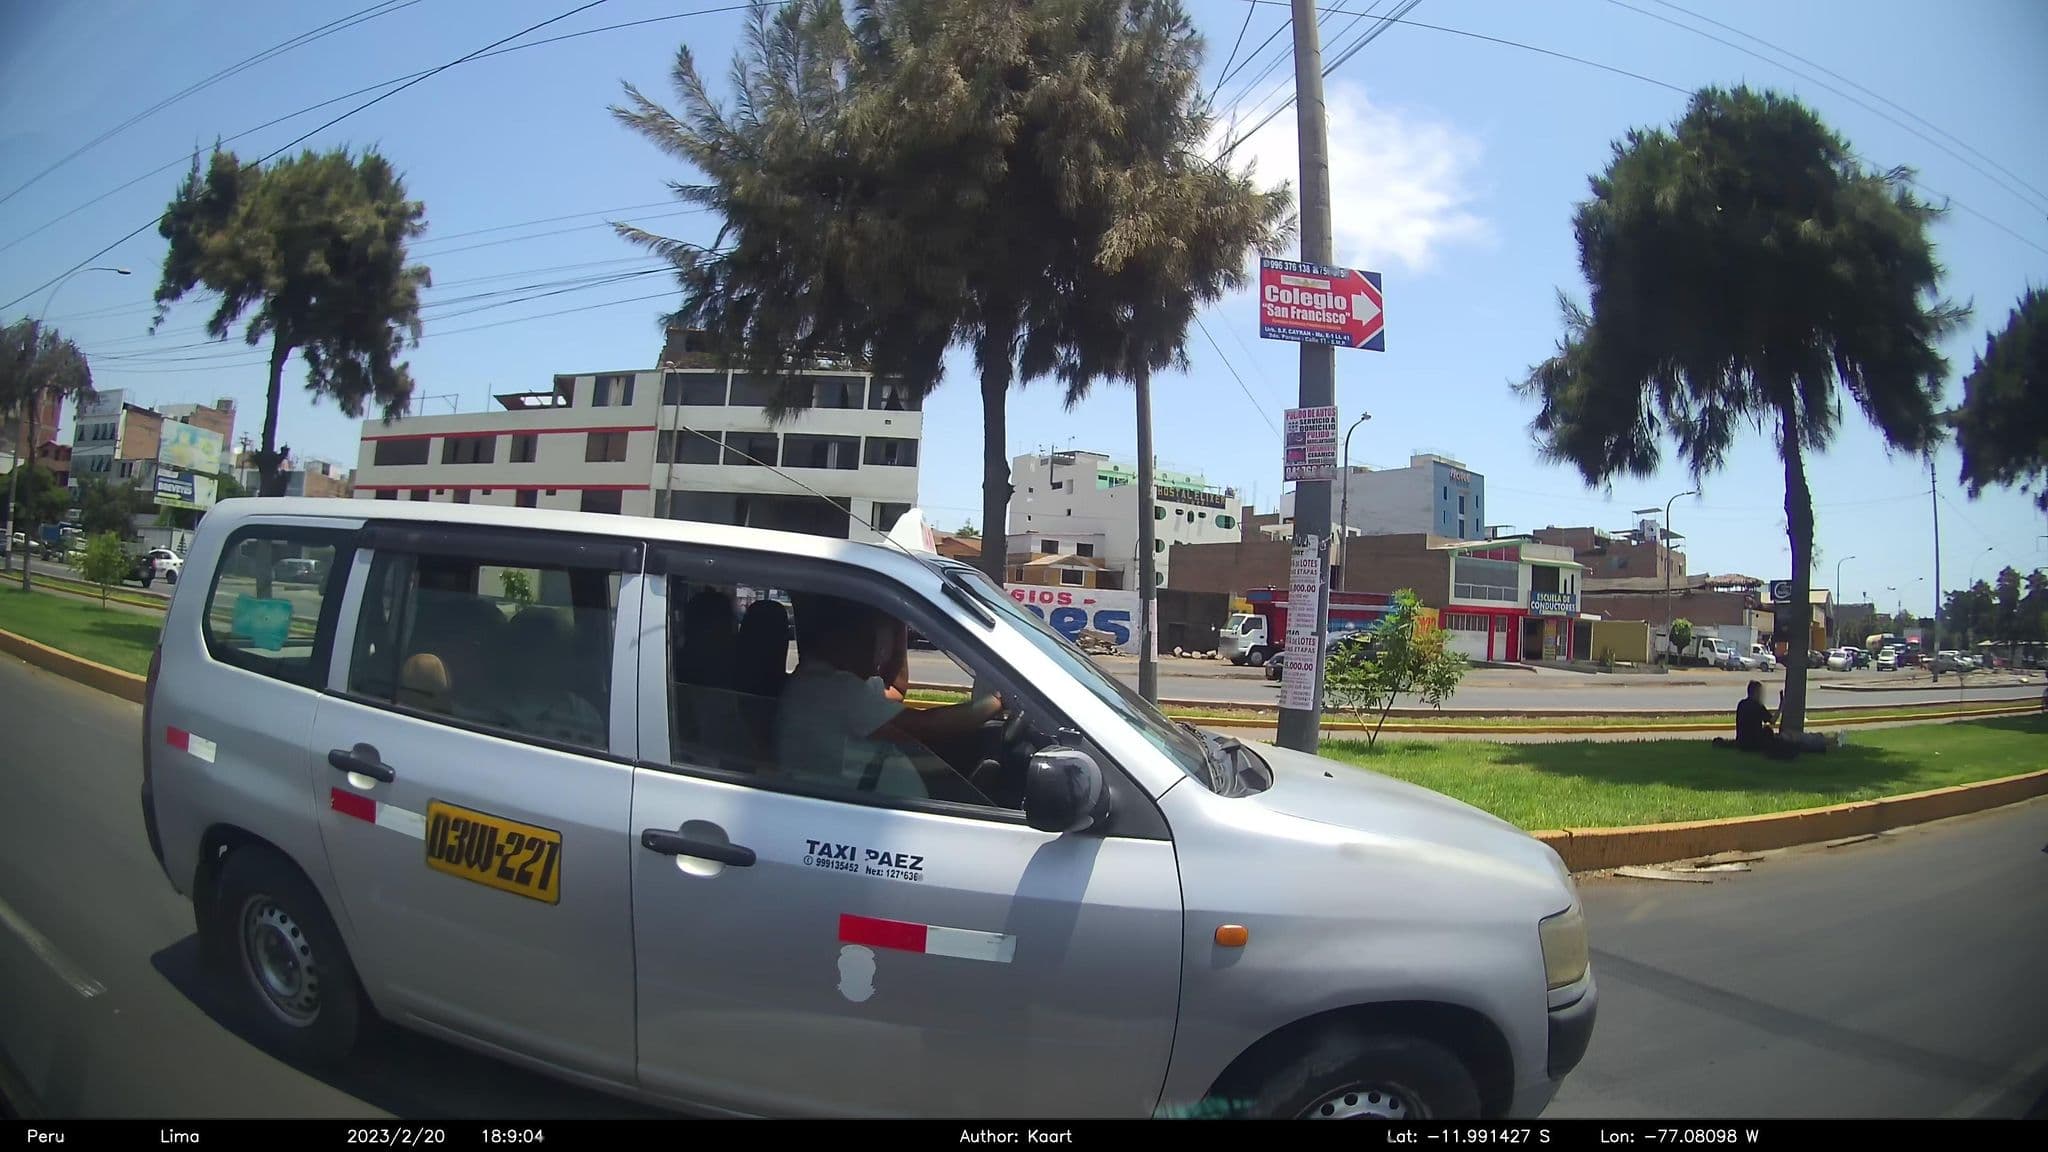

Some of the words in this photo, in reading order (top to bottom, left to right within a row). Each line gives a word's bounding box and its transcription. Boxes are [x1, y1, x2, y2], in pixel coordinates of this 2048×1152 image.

[1264, 284, 1347, 311] Colegio
[1299, 417, 1330, 425] SERVICIO
[1299, 424, 1336, 432] DOMICILIO
[1530, 600, 1576, 611] CONDUCTORES
[806, 839, 857, 861] TAXI
[865, 848, 925, 871] PAEZ
[815, 857, 860, 873] 999135452
